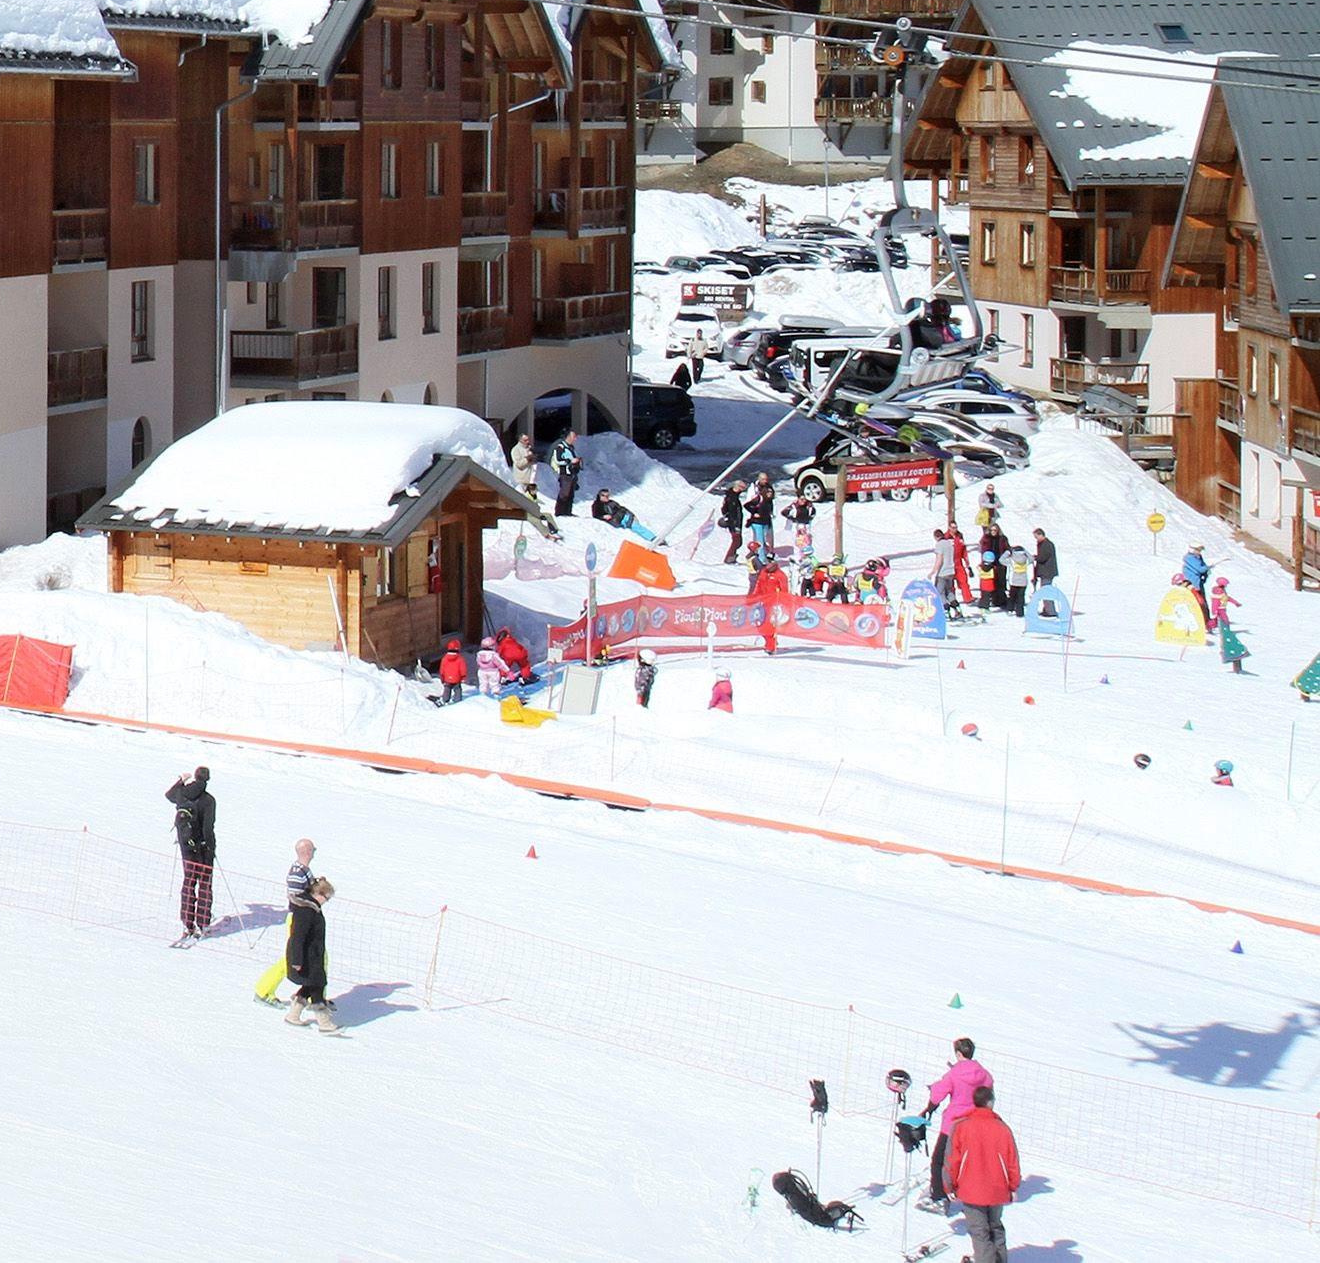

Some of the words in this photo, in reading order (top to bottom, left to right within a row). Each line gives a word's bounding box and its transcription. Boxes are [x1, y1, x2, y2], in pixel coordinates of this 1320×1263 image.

[697, 286, 735, 295] SKISET
[861, 481, 880, 489] CLUB
[673, 608, 695, 625] Piou
[702, 607, 728, 623] Piou
